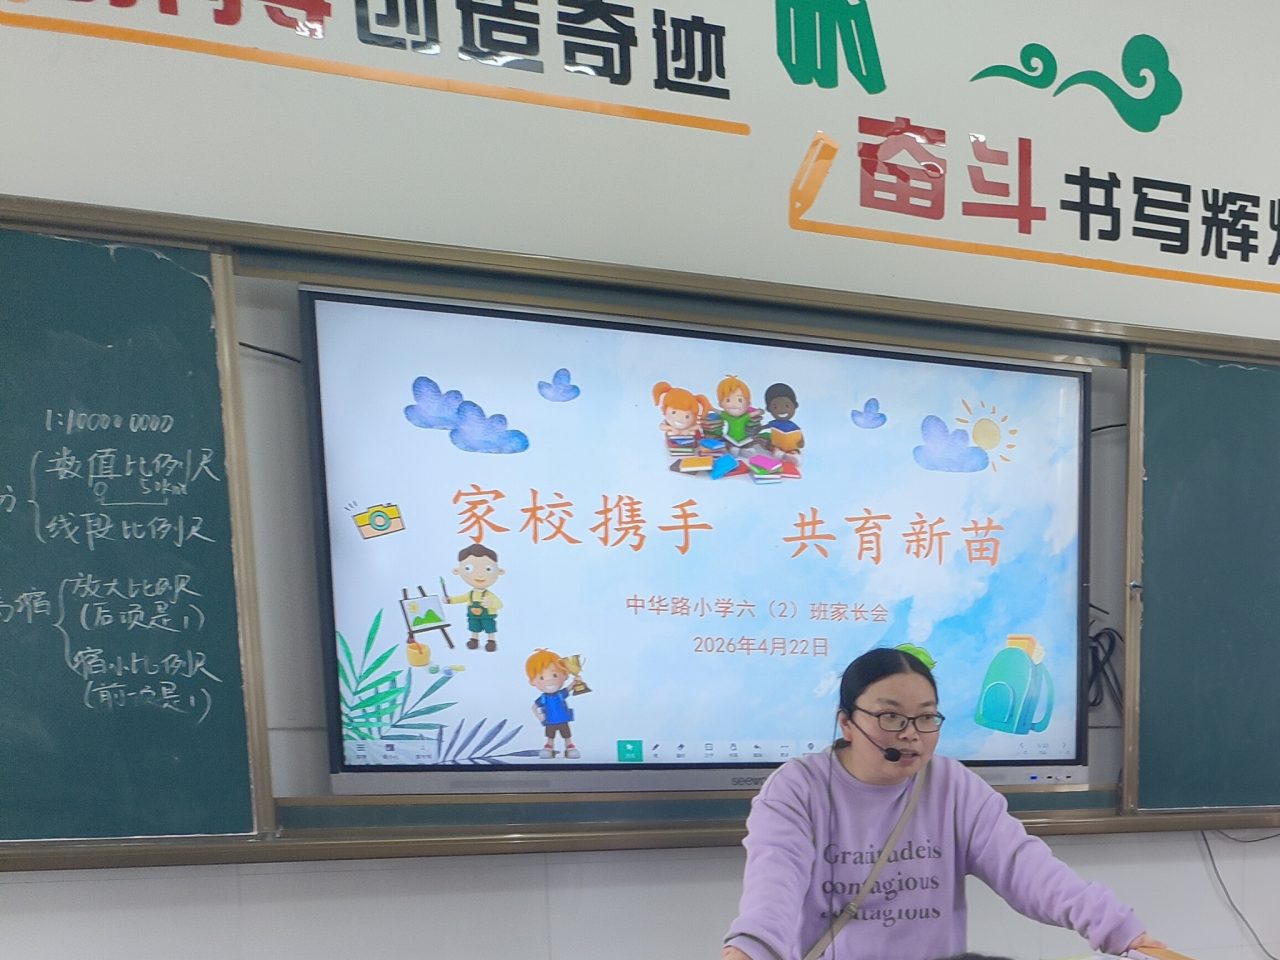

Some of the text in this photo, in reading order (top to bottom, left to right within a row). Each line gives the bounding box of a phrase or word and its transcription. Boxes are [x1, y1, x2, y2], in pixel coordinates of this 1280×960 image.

[106, 0, 731, 100] 创造奇迹
[451, 483, 1005, 567] 家校携手 共育新苗
[692, 636, 829, 658] 2026年4月22日
[822, 872, 940, 901] conagious
[820, 907, 941, 928] tagious
